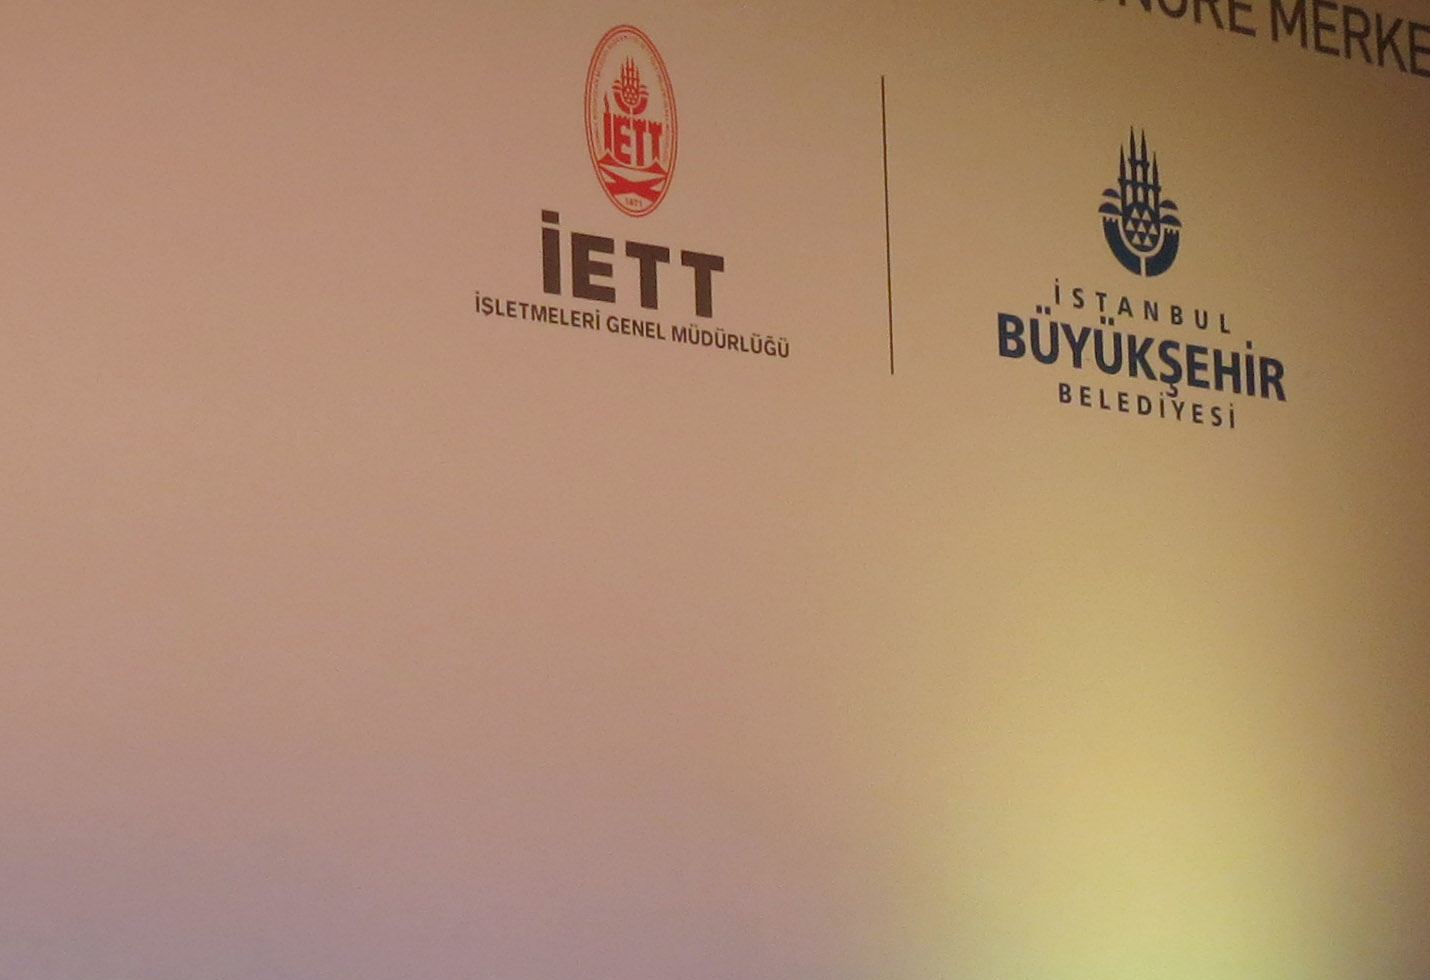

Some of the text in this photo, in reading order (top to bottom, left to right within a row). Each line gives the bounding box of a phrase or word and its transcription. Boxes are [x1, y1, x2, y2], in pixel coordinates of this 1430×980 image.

[541, 209, 725, 319] İETT
[475, 290, 790, 359] İŞLETMELERİ GENEL MÜDÜRLÜĞÜ
[1053, 278, 1231, 334] İSTANBUL
[997, 305, 1288, 402] BÜYÜKŞEHİR
[1058, 382, 1236, 429] BELEDİYESİ
